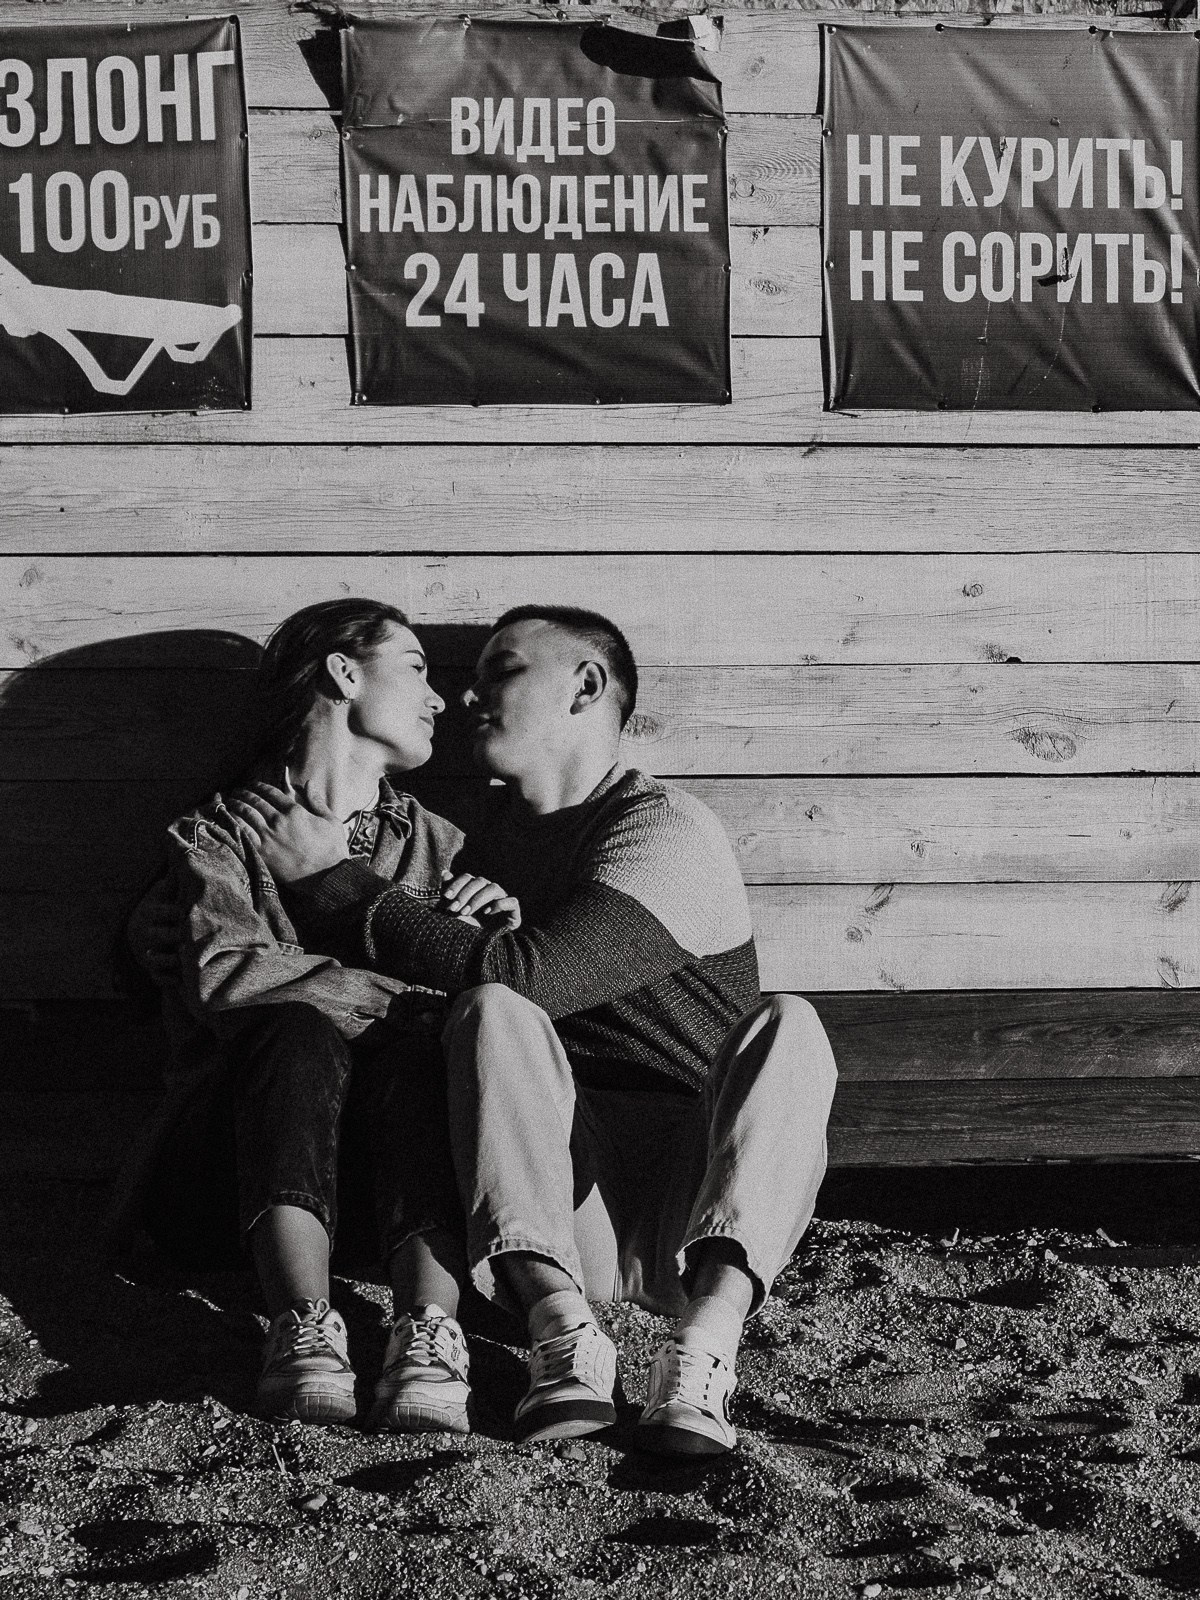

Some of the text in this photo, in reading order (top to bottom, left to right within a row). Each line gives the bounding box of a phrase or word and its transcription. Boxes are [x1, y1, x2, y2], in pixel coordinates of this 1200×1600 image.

[450, 97, 616, 163] ВИДЕО
[358, 173, 709, 239] НАБЛЮДЕНИЕ
[846, 134, 1184, 210] НЕ КУРИТЬ!
[404, 252, 669, 328] 24 ЧАСА
[849, 230, 1184, 304] НЕ СОРИТЬ!
